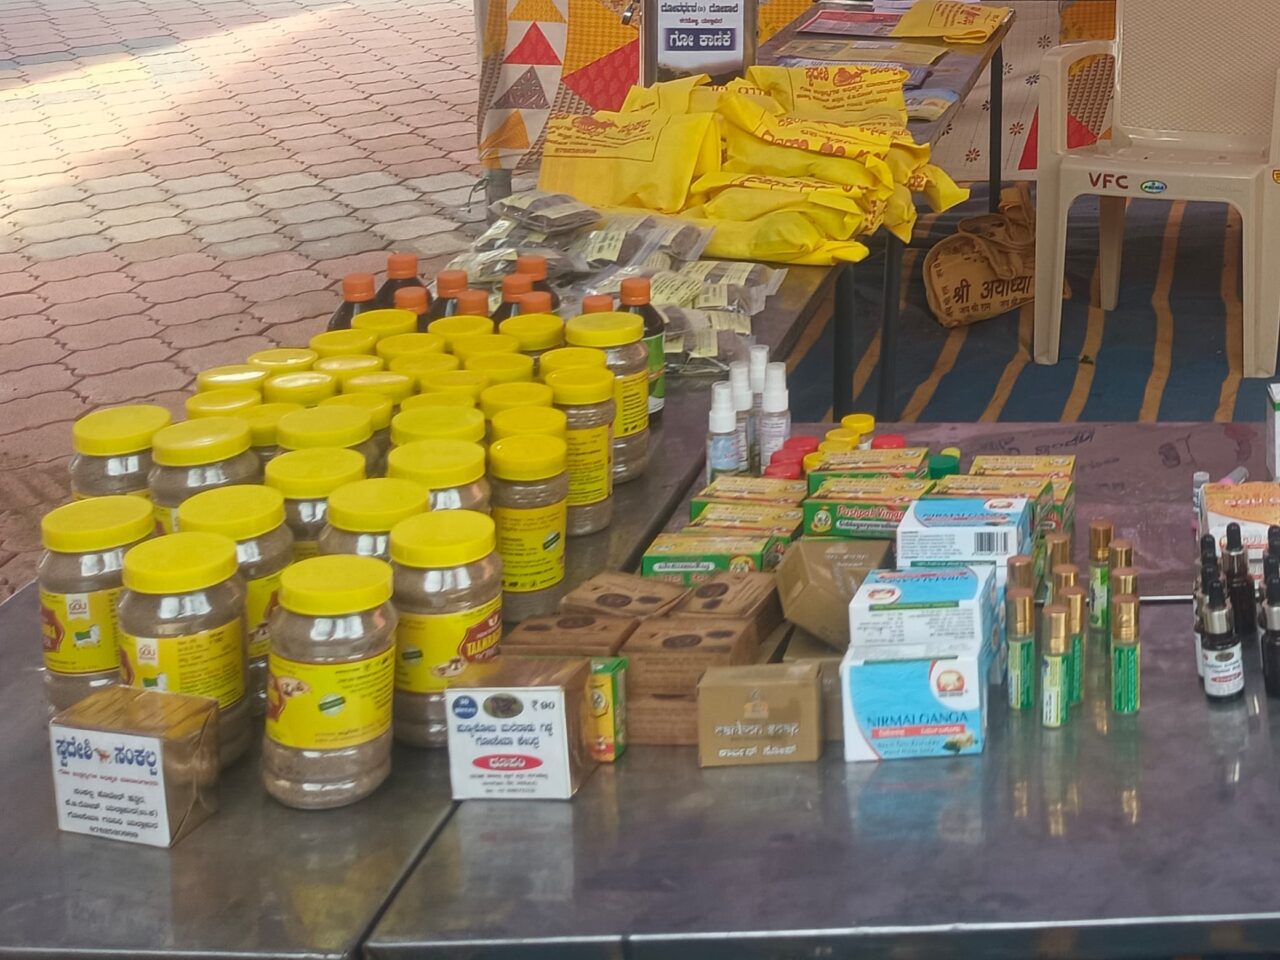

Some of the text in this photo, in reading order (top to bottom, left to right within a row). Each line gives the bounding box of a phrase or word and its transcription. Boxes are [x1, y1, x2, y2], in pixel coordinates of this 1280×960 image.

[669, 30, 731, 47] ಗೋ ಕಾಣಿಕೆ
[1089, 172, 1128, 189] VFC
[953, 278, 971, 304] श्री
[56, 736, 158, 776] ಸ್ವದೇಶಿ ಸಂಕಲ್ಪ
